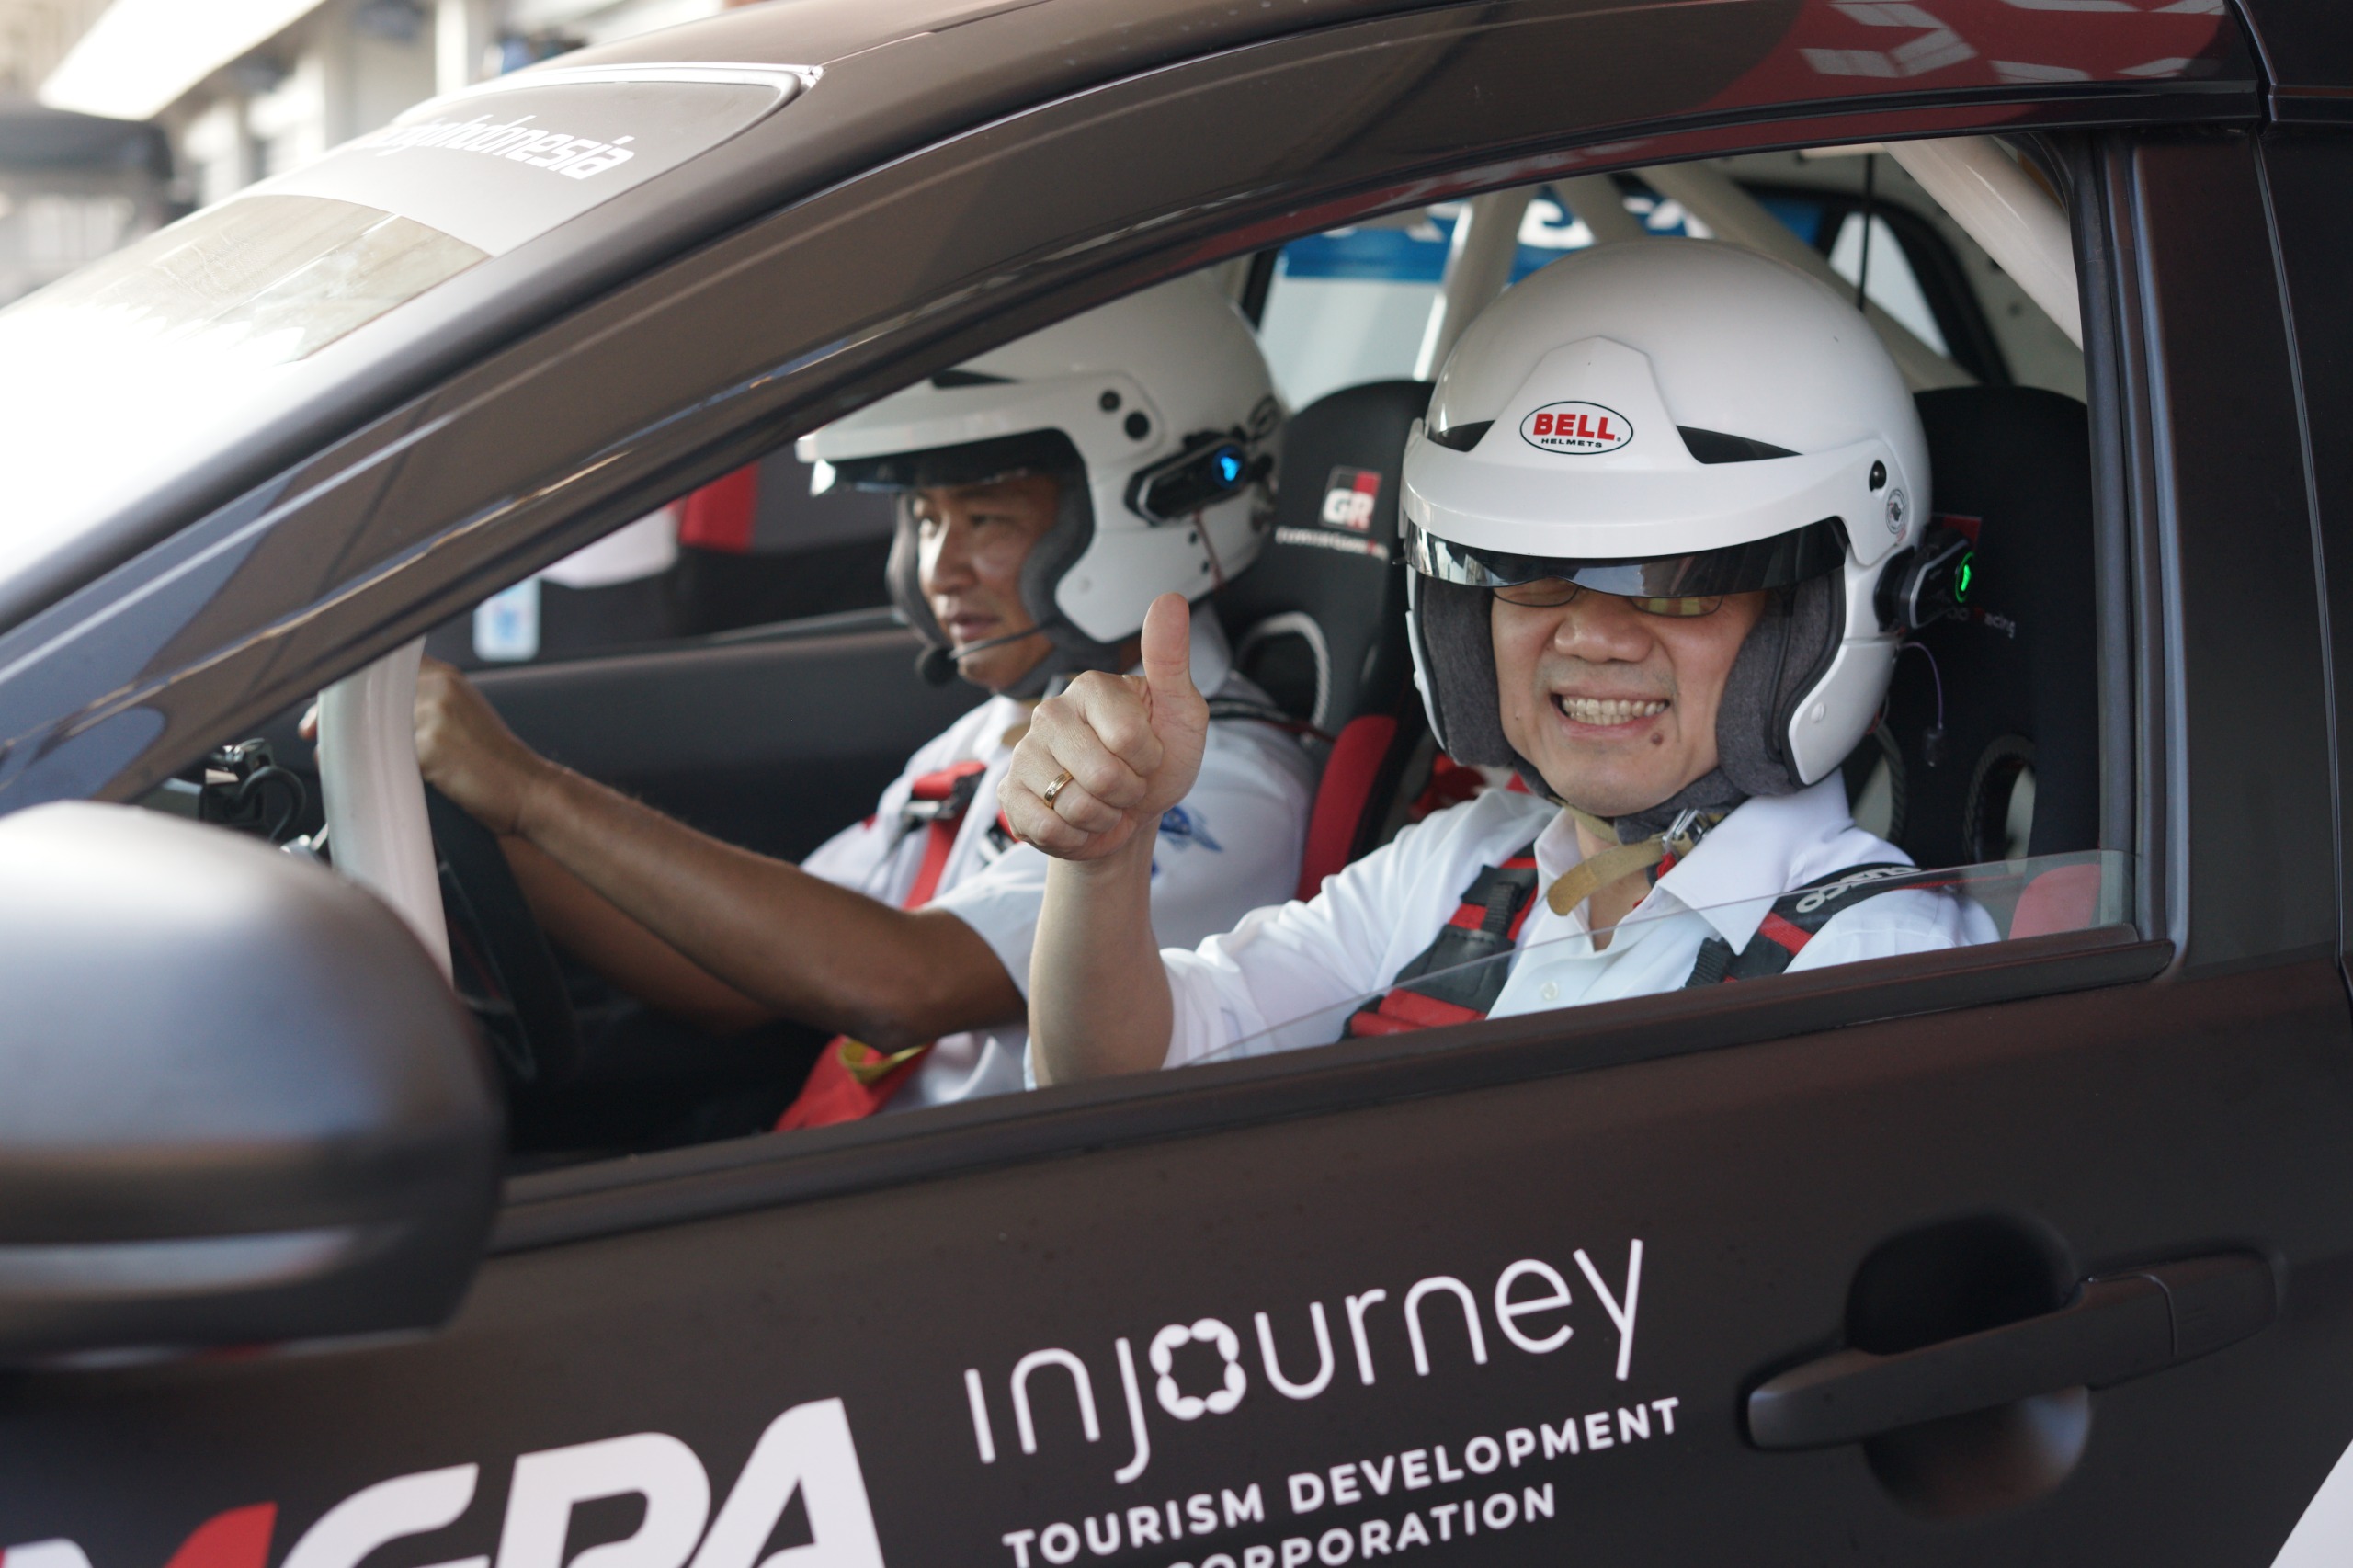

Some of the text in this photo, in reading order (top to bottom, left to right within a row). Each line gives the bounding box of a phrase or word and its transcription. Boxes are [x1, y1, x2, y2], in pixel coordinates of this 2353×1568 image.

[1532, 413, 1616, 441] BELL
[1540, 437, 1603, 449] HELMETS
[1323, 487, 1375, 529] GR
[1002, 1396, 1679, 1568] TOURISM DEVELOPMENT
